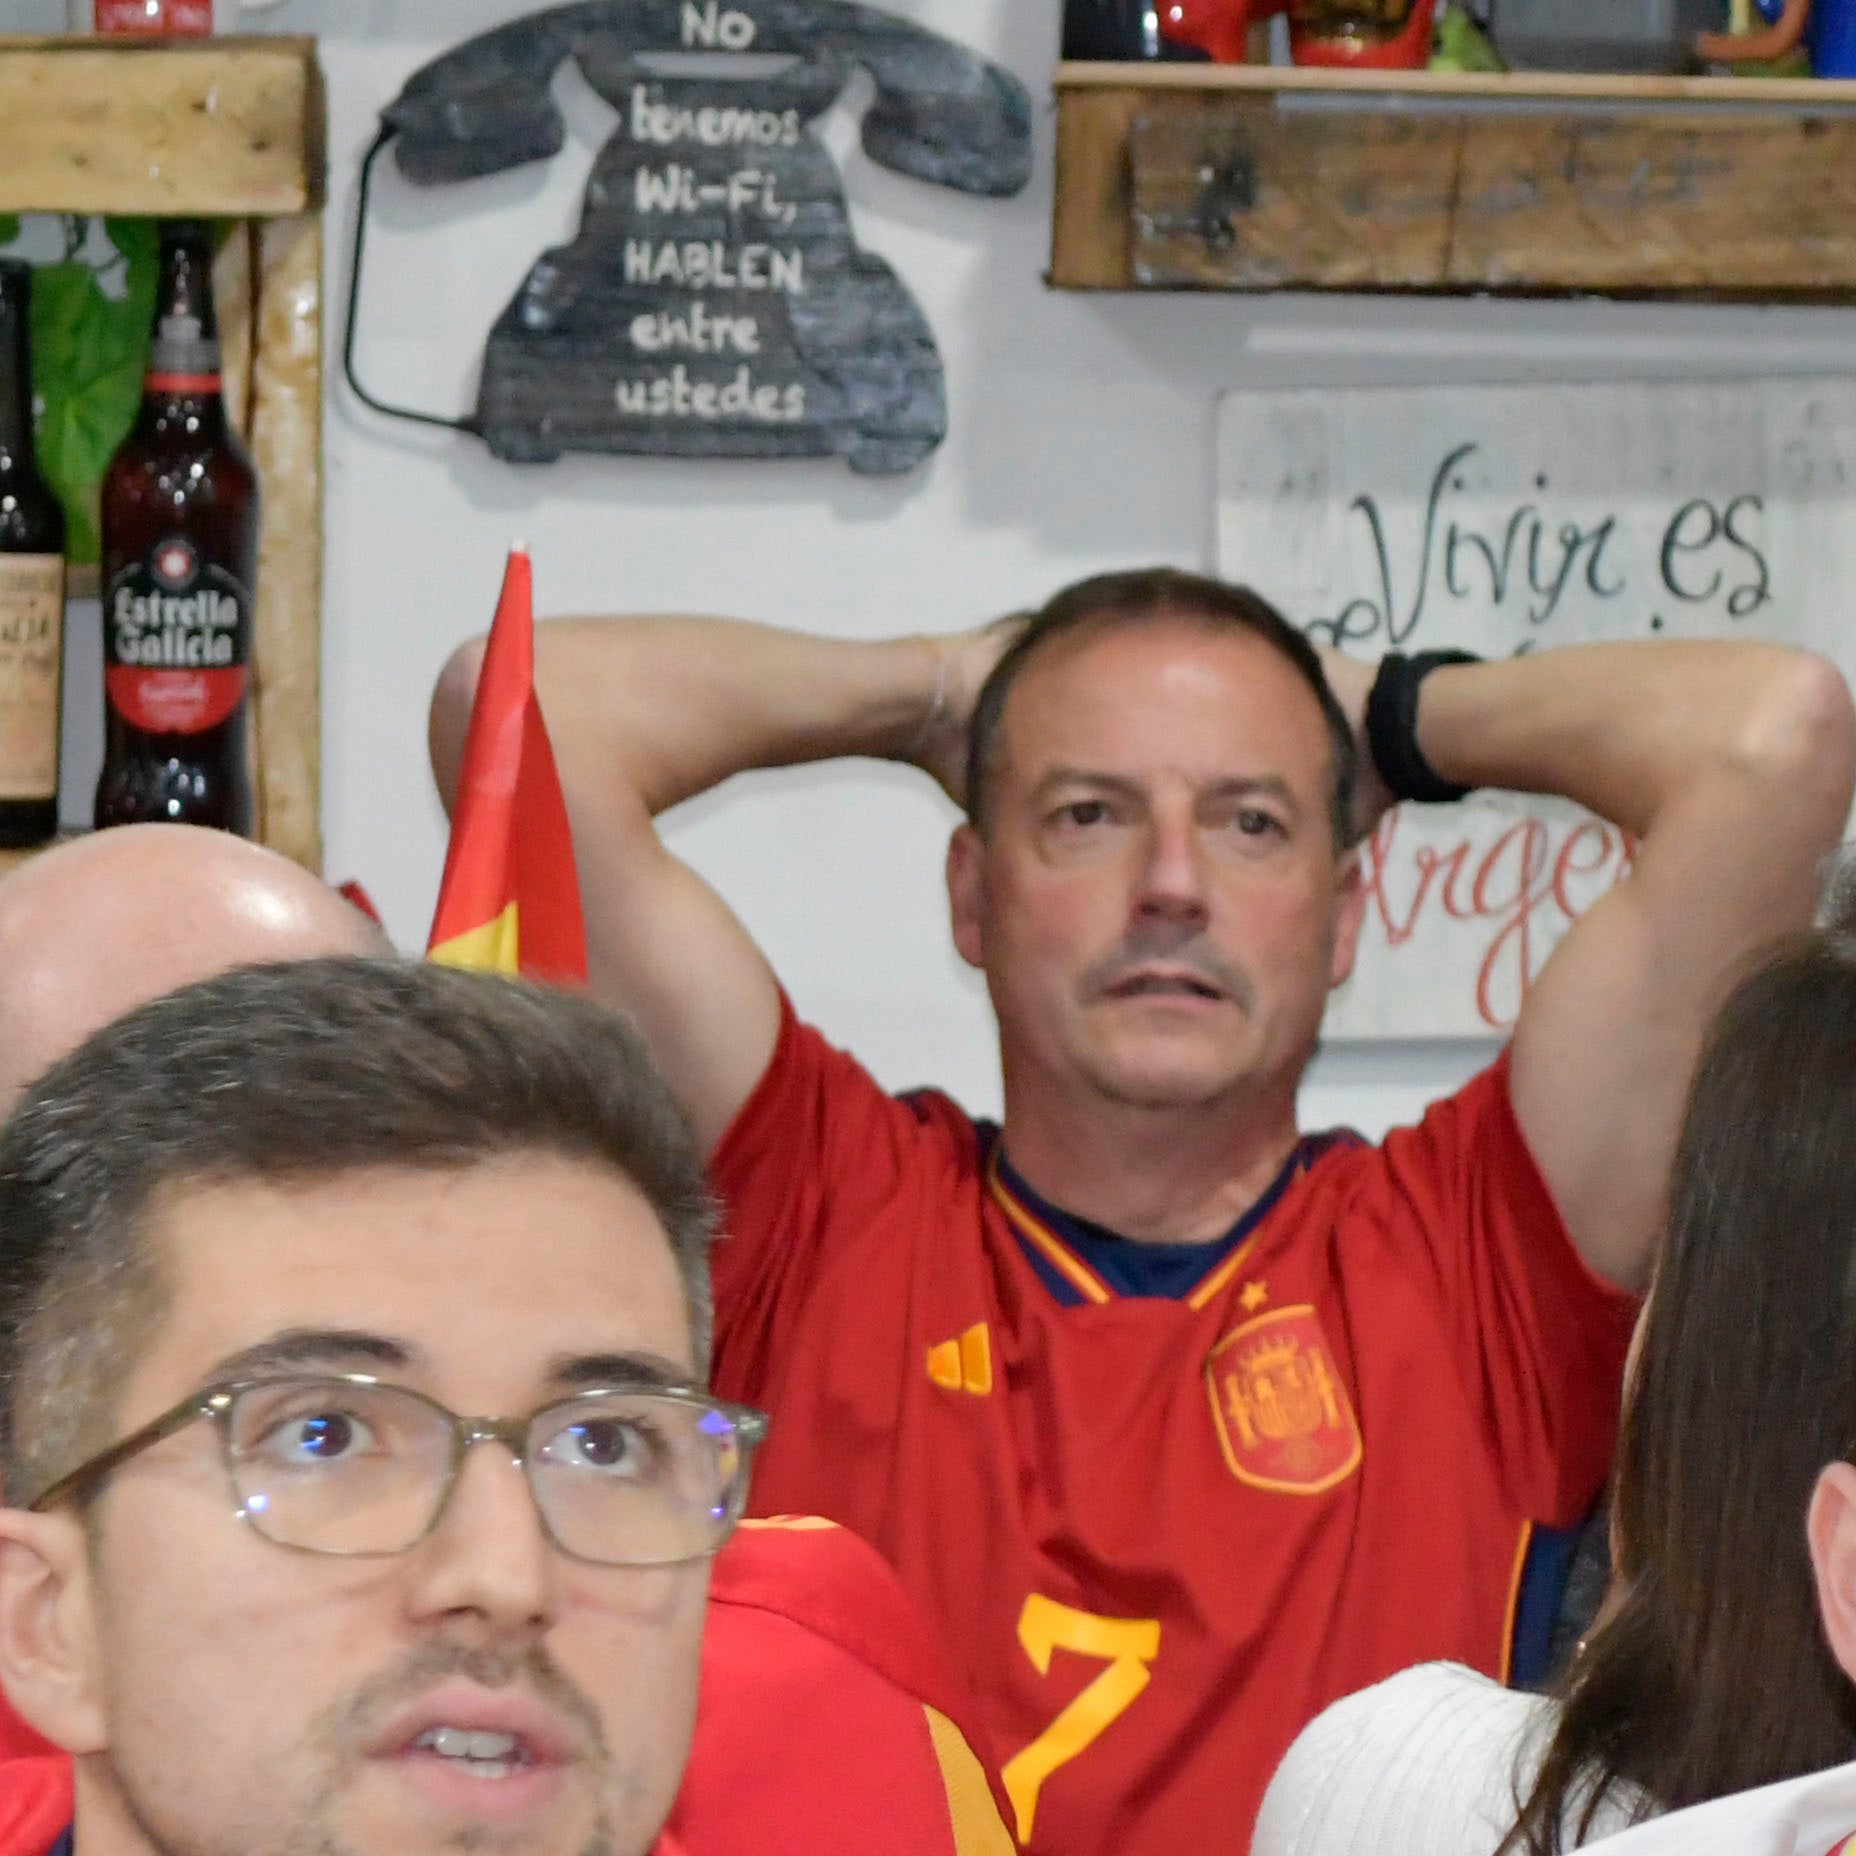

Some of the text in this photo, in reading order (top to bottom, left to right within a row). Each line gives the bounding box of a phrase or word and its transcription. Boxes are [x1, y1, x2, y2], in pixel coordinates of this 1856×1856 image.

[681, 5, 756, 49] No
[630, 85, 800, 145] tenemos
[634, 165, 797, 223] Wi-Fi,
[623, 238, 804, 294] HABLEN
[629, 309, 760, 355] entre
[615, 369, 806, 422] ustedes
[1351, 441, 1771, 645] Vivir es
[114, 586, 239, 628] Estrella
[115, 622, 234, 665] Galicia
[1001, 1592, 1161, 1845] 7
